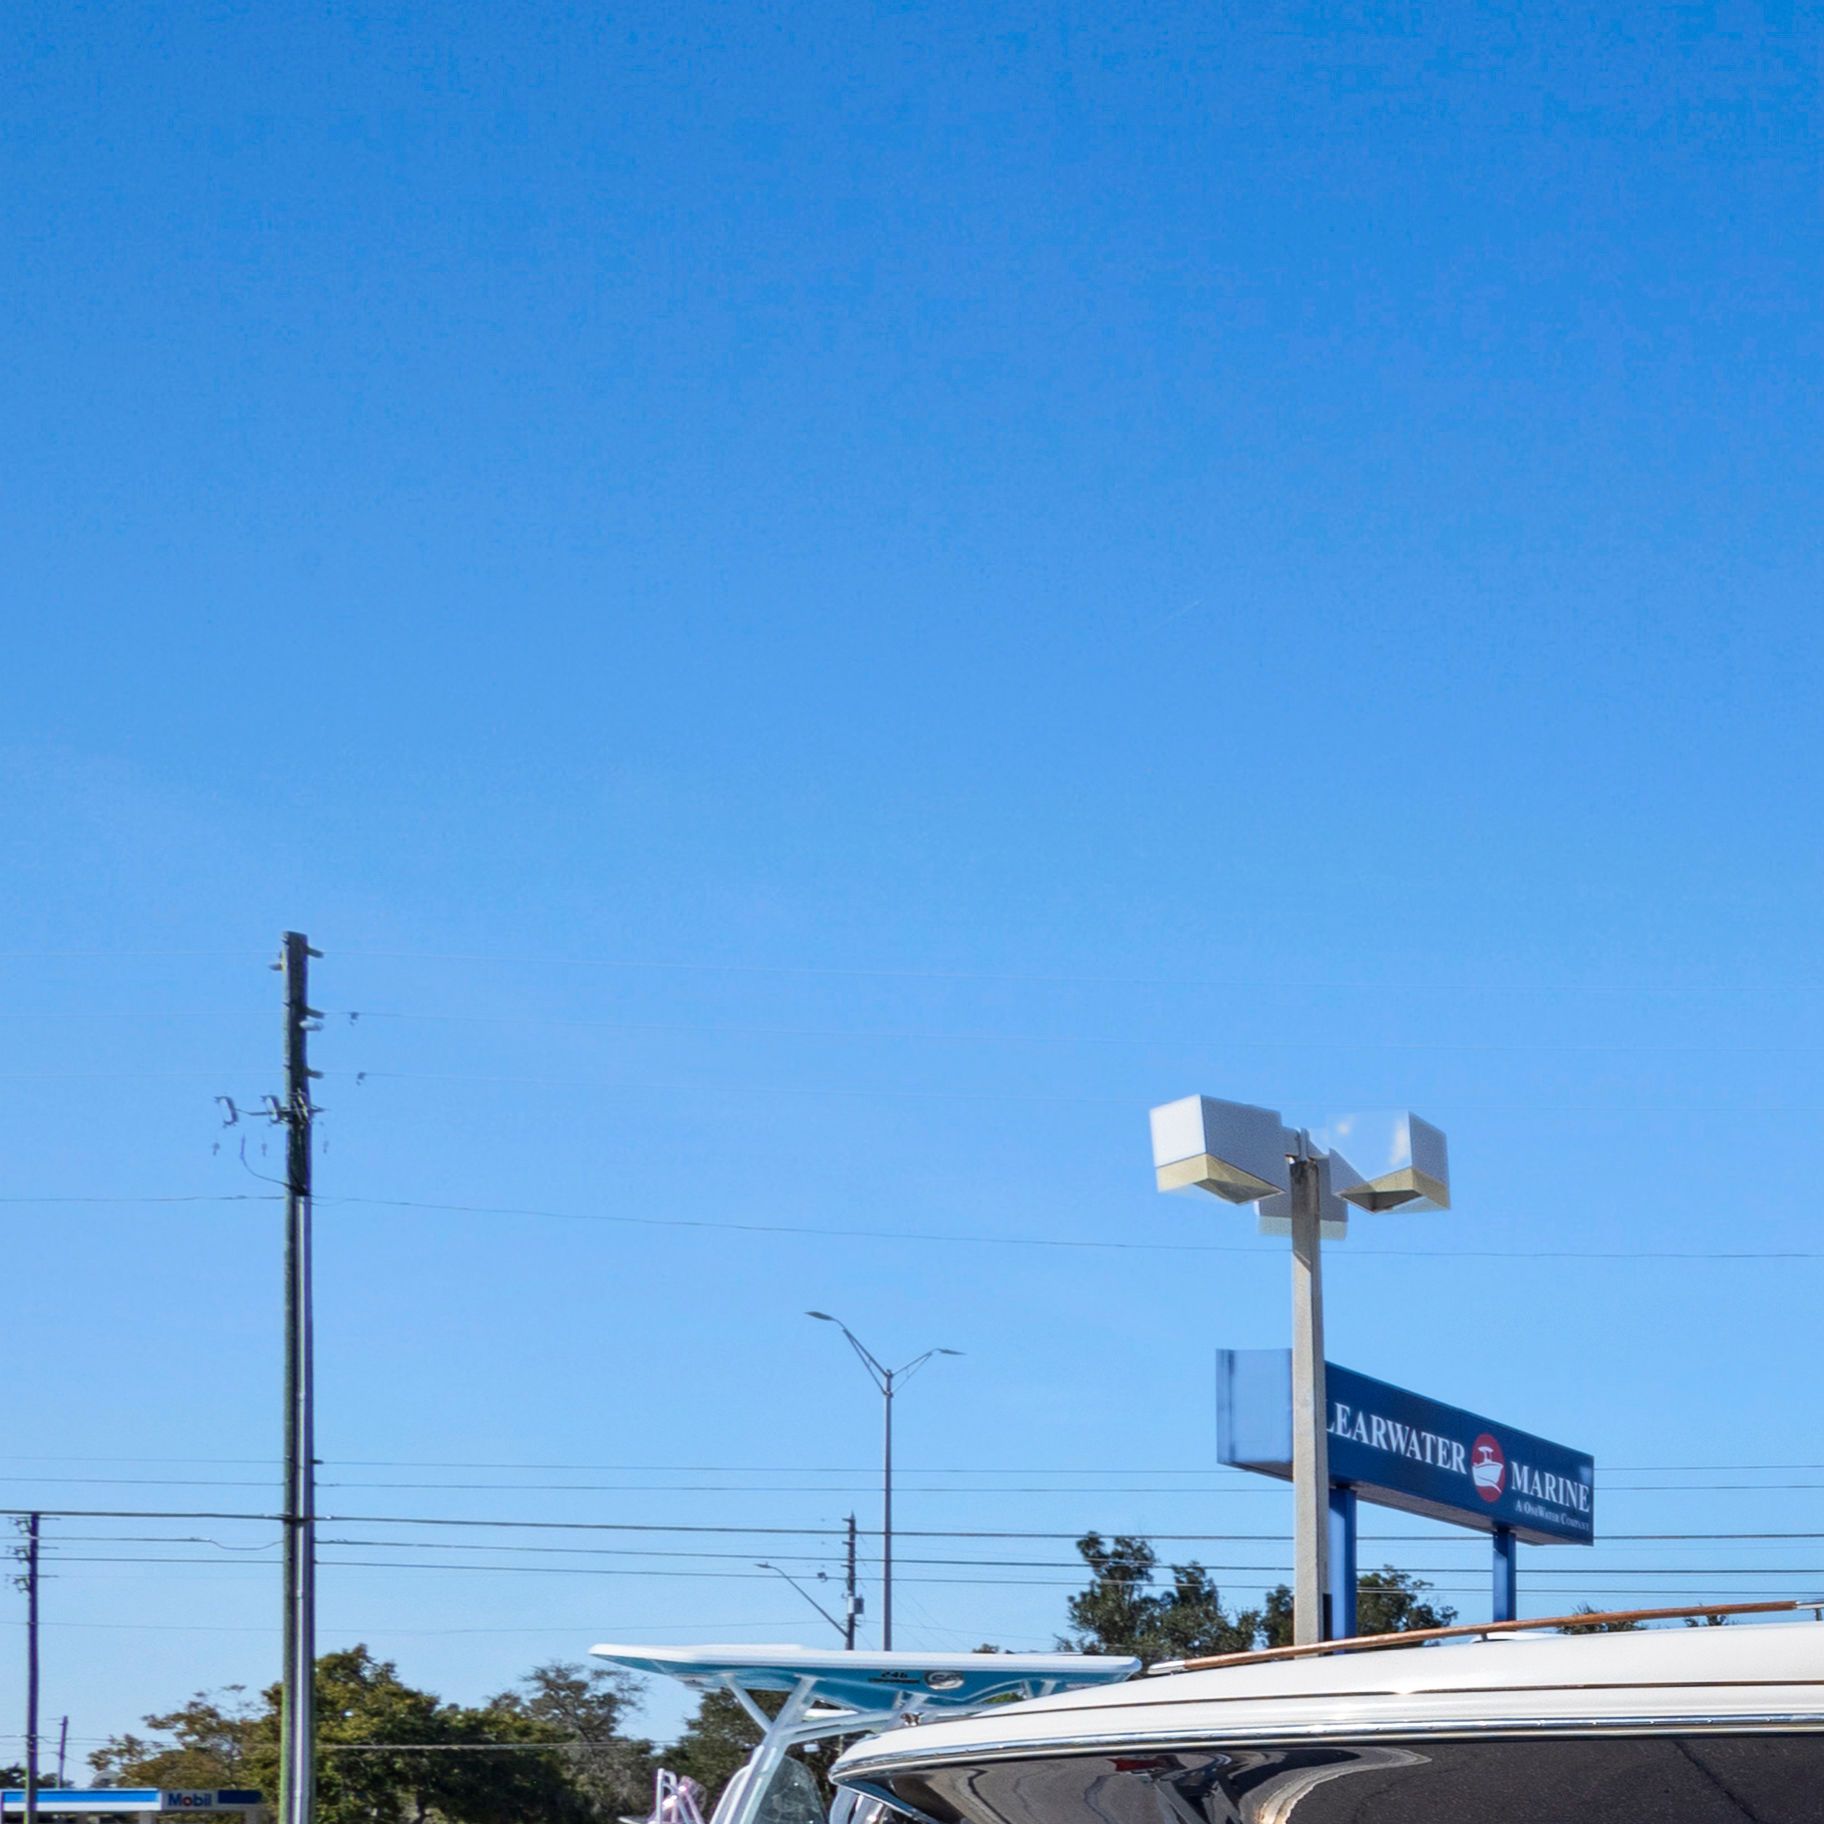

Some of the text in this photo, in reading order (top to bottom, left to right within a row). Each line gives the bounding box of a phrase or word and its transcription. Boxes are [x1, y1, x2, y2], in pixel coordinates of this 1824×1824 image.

[1327, 1402, 1590, 1513] EARWATER MARINE
[168, 1792, 212, 1807] Mobil
